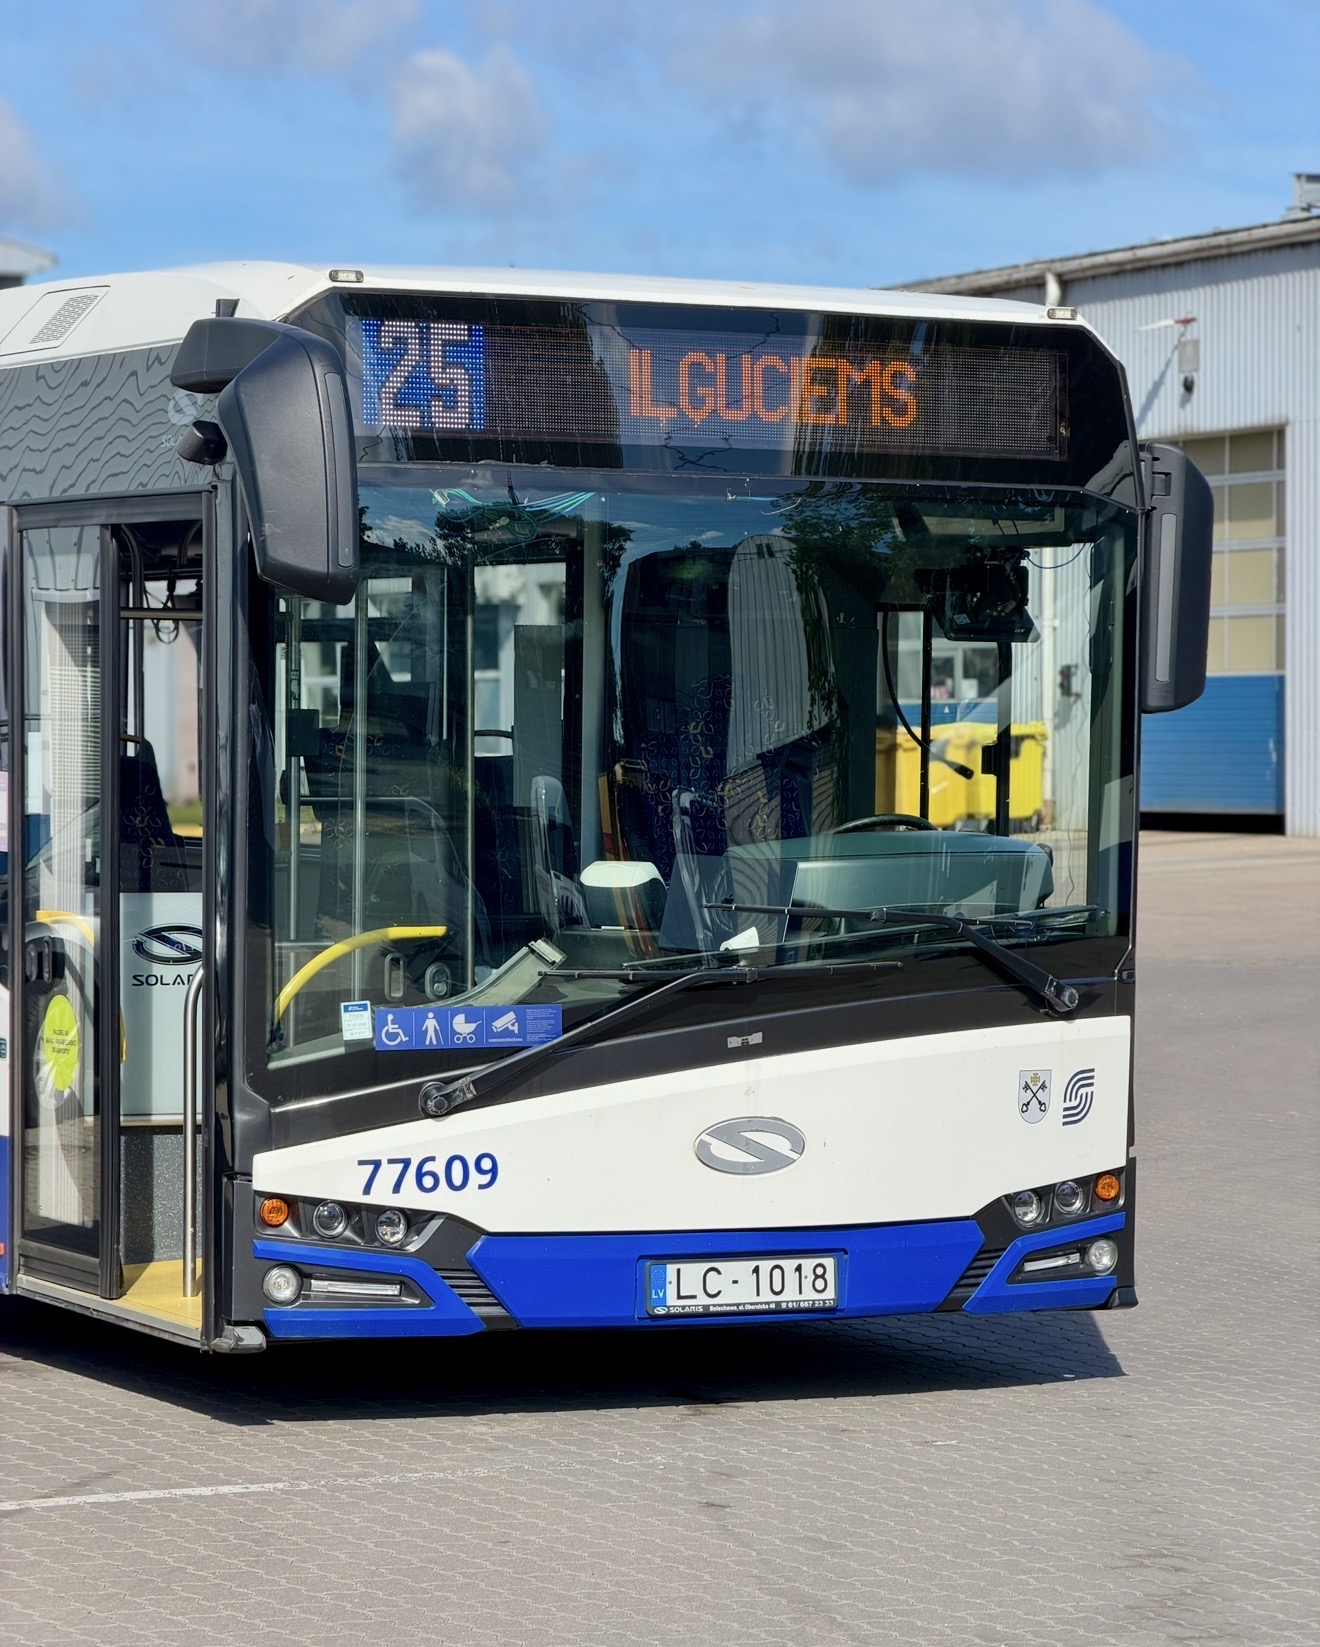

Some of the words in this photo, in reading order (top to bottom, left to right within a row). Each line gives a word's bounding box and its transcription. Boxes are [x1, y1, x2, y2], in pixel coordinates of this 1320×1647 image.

[379, 321, 473, 429] 25
[630, 349, 917, 428] IĻĢUCIEMS
[357, 1152, 499, 1196] 77609
[652, 1289, 664, 1298] LV
[669, 1305, 703, 1313] SOLARIS
